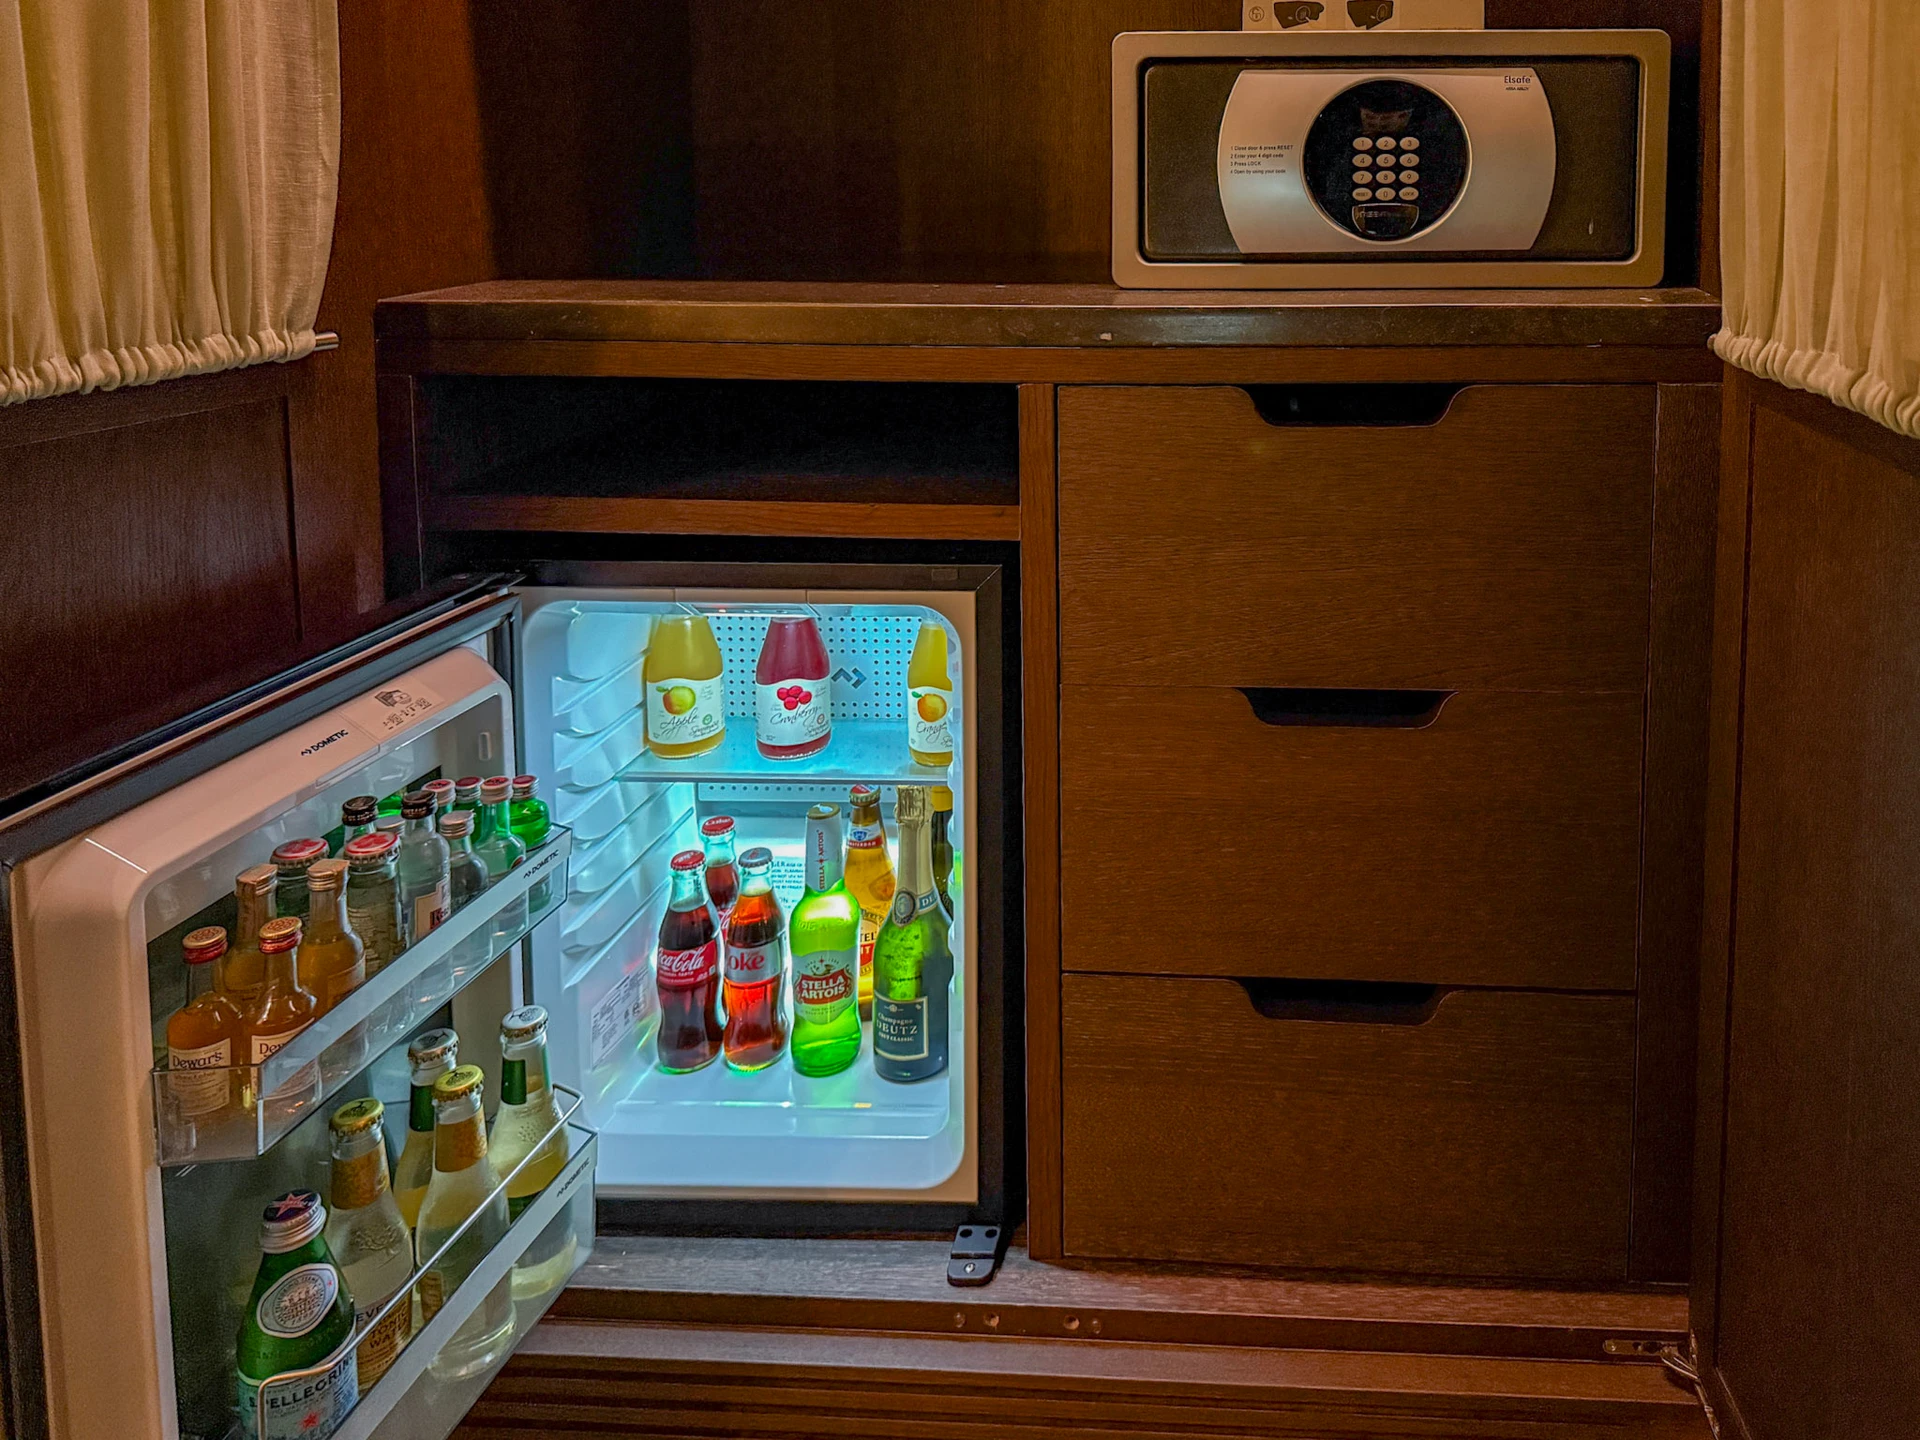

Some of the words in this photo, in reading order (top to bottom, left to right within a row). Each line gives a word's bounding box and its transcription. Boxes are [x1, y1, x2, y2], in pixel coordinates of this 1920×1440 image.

[1504, 75, 1531, 84] Elsafe
[660, 707, 698, 738] Apple
[770, 702, 820, 728] Cranberry
[310, 729, 349, 752] DOMETIC
[531, 849, 560, 874] DOMETIC
[726, 950, 766, 973] oke
[801, 975, 844, 990] STELLA
[801, 986, 845, 1000] ARTOIS
[876, 1020, 918, 1036] DEUTZ
[877, 1012, 914, 1026] Champagne
[172, 1051, 223, 1070] Dewar's
[564, 1157, 590, 1190] DOMETIC
